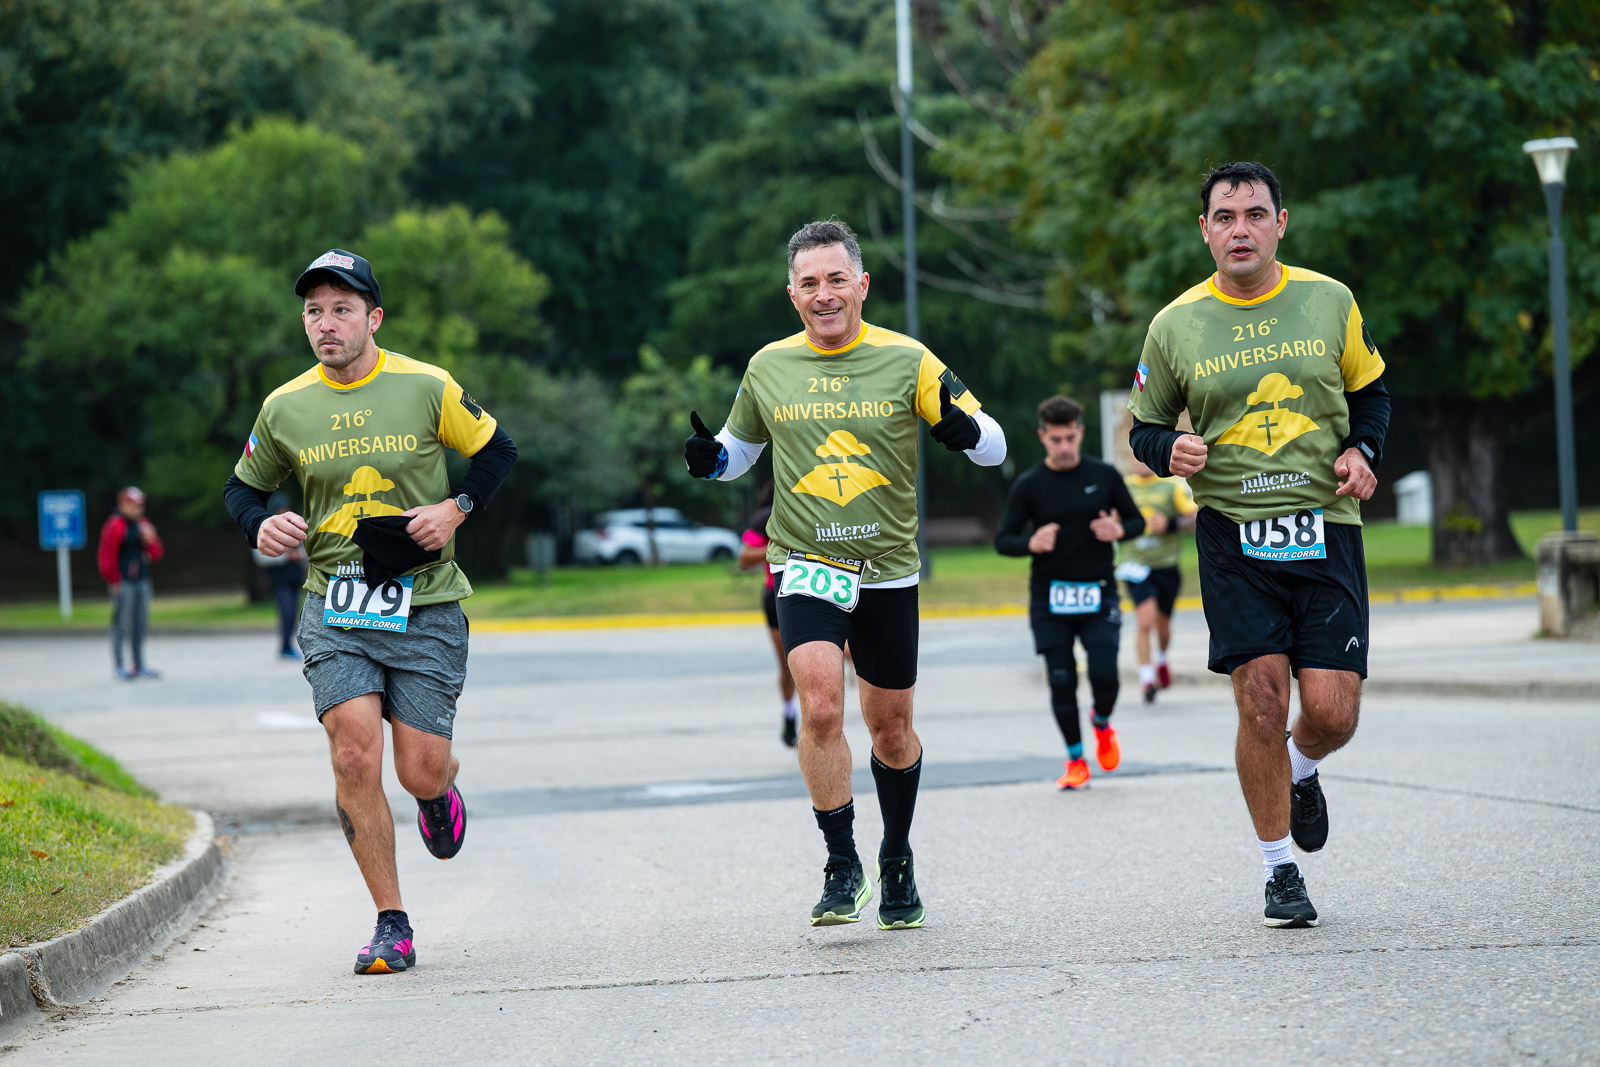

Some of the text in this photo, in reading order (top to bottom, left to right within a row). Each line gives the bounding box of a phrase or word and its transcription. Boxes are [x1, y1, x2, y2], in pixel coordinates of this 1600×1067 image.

[1231, 317, 1278, 342] 216°
[1194, 339, 1326, 381] ANIVERSARIO
[808, 376, 850, 393] 216°
[330, 409, 373, 431] 216°
[773, 401, 894, 423] ANIVERSARIO
[299, 434, 418, 466] ANIVERSARIO
[1240, 471, 1310, 494] julicroc
[815, 522, 880, 542] julicroc
[1244, 509, 1317, 550] 058
[1246, 548, 1321, 559] DIAMANTE CORRE
[786, 564, 852, 604] 203
[1055, 583, 1094, 607] 036
[331, 577, 404, 617] 079
[327, 616, 402, 630] DIAMANTE CORRE
